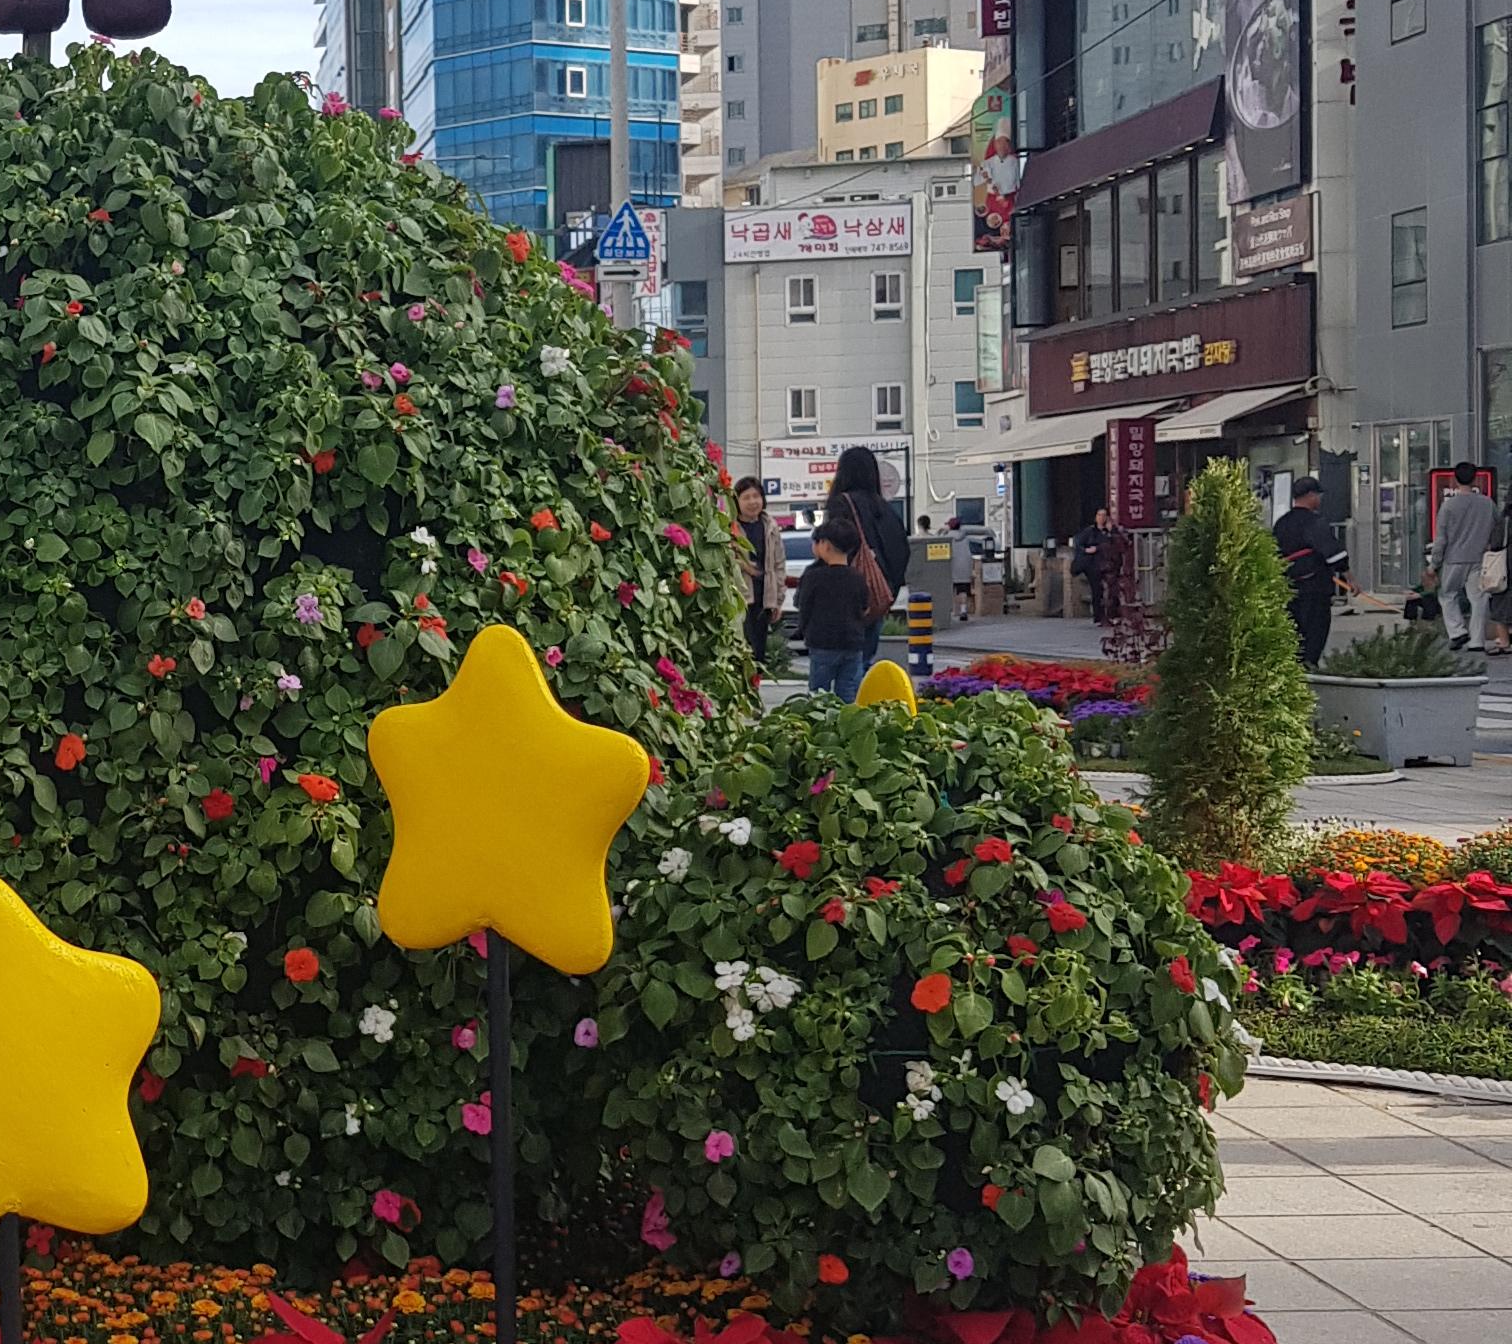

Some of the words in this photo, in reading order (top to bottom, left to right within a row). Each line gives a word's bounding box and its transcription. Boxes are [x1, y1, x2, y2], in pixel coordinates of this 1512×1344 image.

[731, 221, 791, 243] 낙곱새
[843, 216, 905, 238] 낙삼새
[797, 242, 839, 253] 개미집
